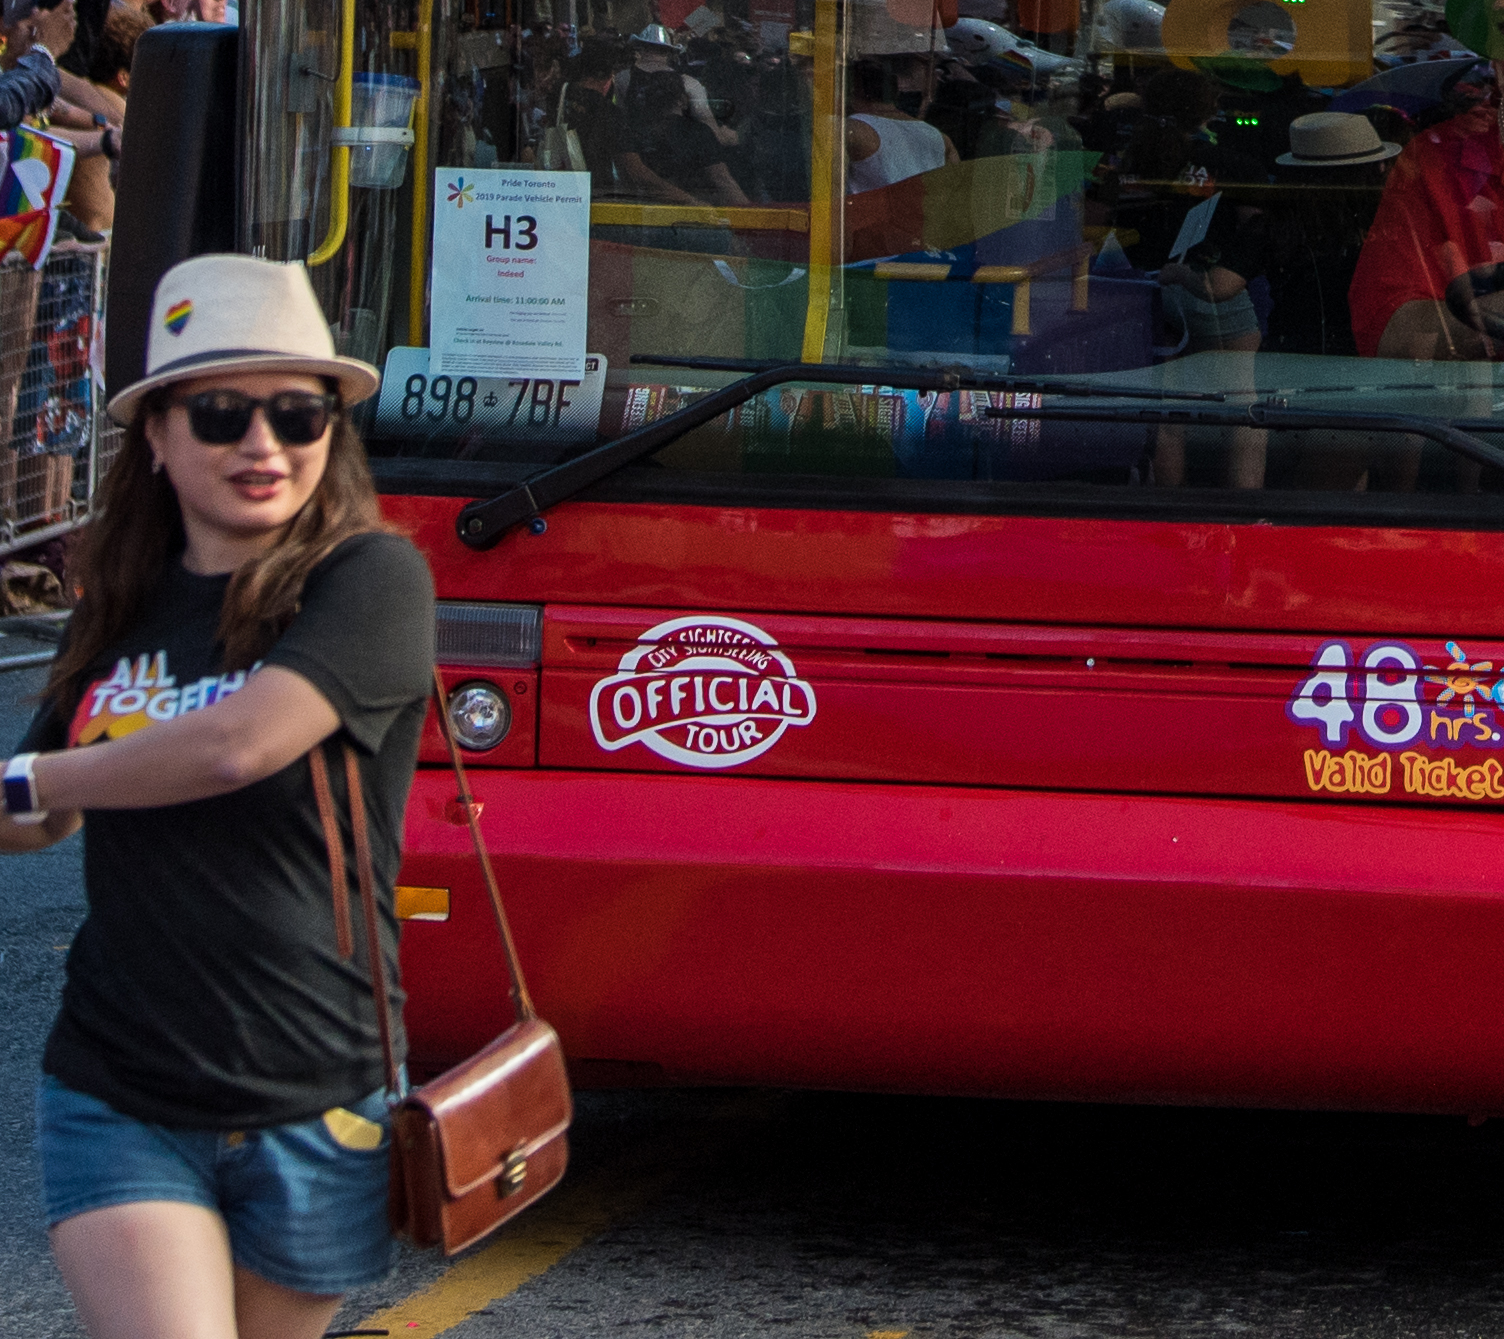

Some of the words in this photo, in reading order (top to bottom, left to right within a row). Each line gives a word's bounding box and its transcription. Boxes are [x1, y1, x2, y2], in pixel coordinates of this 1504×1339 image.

[475, 192, 495, 201] 2019
[496, 193, 523, 202] Parade
[524, 194, 554, 203] Vehicle
[555, 195, 583, 204] Permit
[501, 179, 522, 188] Pride
[523, 179, 556, 189] Toronto
[484, 213, 539, 251] H3
[486, 254, 510, 265] Group
[465, 294, 492, 304] Arrival
[550, 297, 566, 306] AM
[401, 374, 479, 425] 898
[110, 650, 175, 688] ALL
[647, 644, 679, 669] CITY
[613, 676, 803, 729] OFFICIAL
[1292, 644, 1424, 744] 48
[684, 720, 763, 753] TOUR
[1304, 750, 1391, 793] Valid
